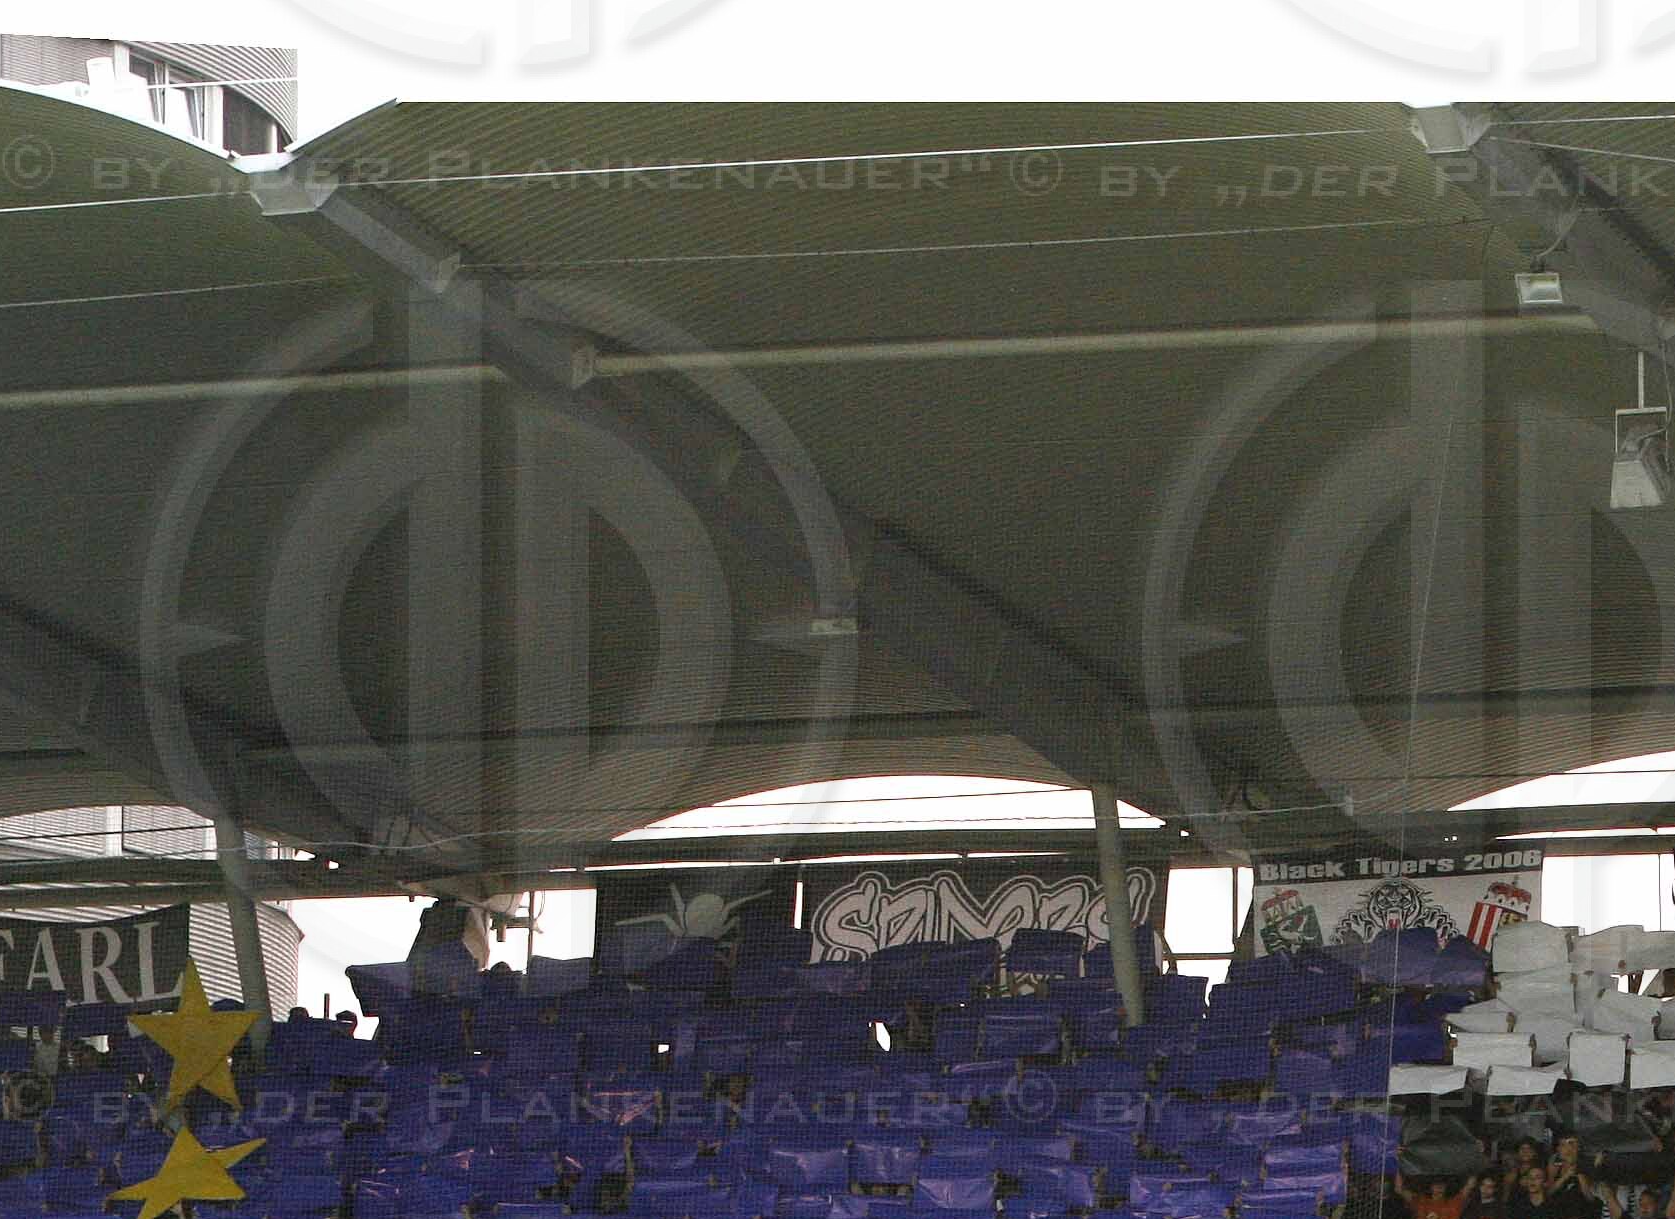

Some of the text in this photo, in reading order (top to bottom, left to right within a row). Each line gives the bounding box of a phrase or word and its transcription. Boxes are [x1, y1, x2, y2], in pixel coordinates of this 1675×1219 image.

[1259, 847, 1542, 881] Black Tigers 2006
